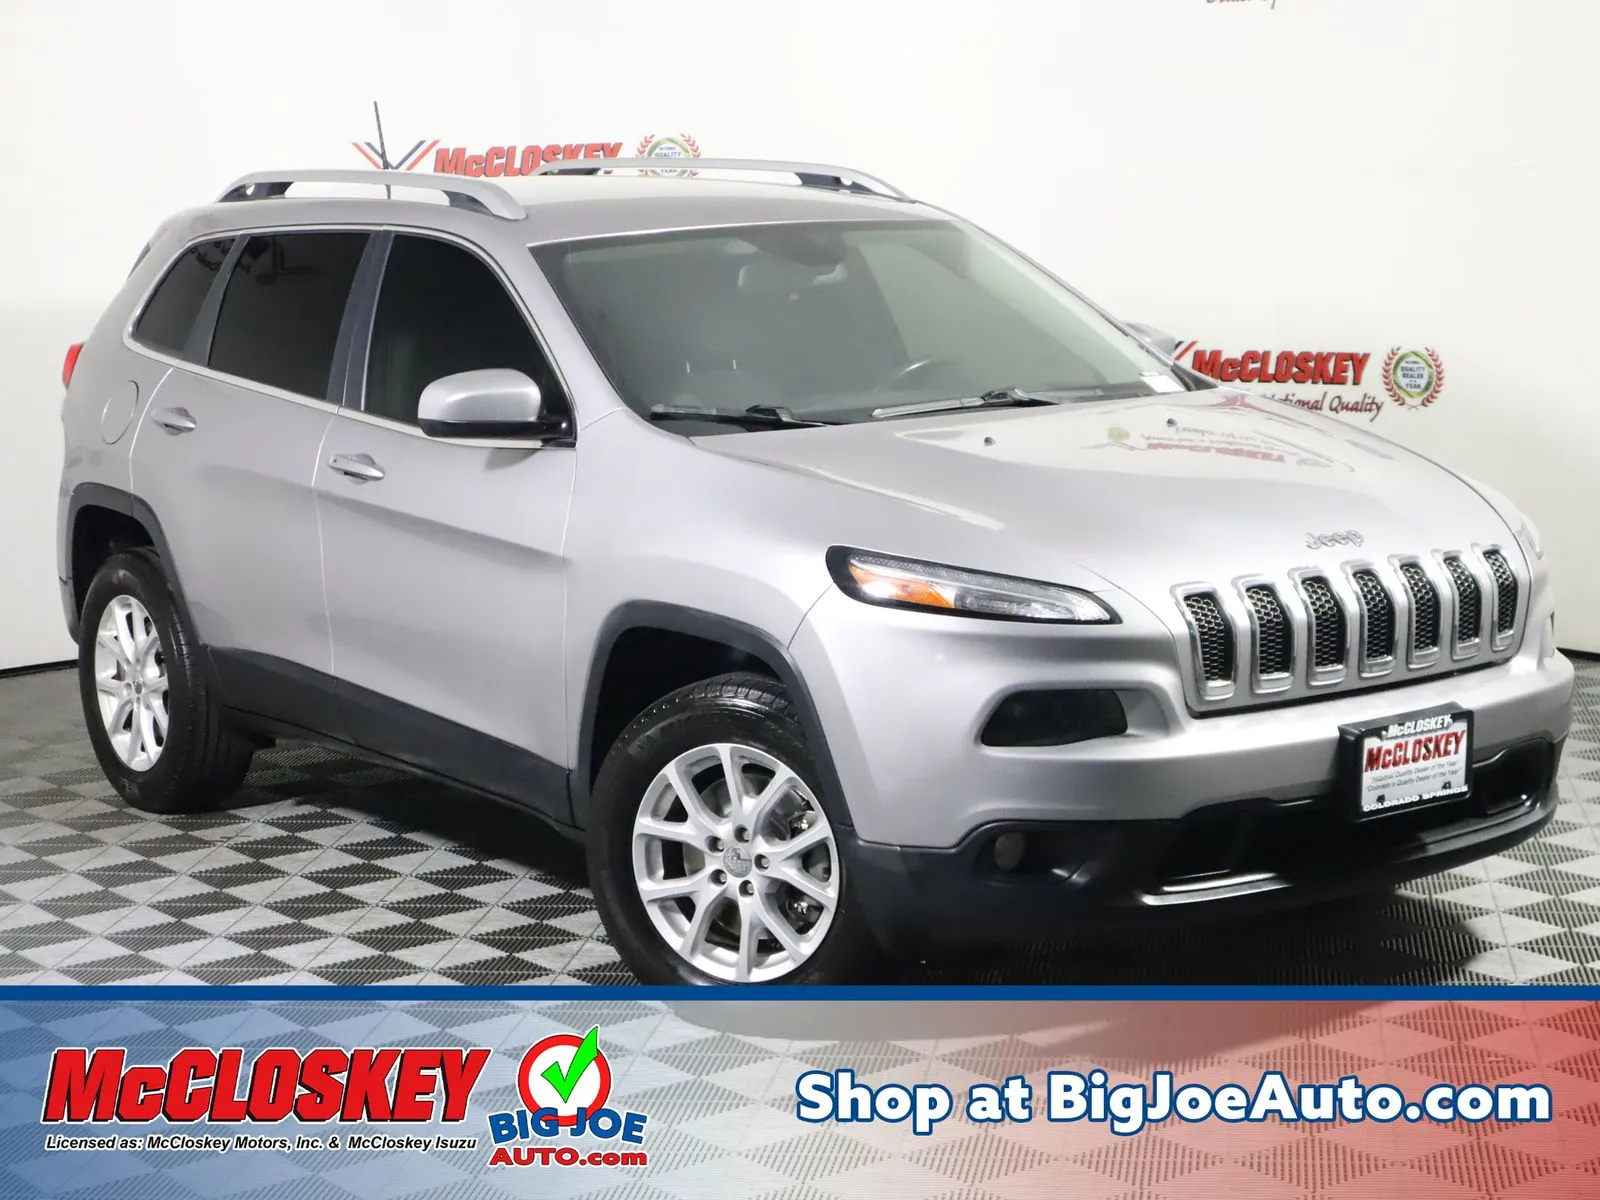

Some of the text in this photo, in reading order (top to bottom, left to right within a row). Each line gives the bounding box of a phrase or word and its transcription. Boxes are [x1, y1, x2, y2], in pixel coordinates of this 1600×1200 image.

[1192, 350, 1371, 385] McCLOSKEY
[1328, 392, 1384, 422] Quality
[1304, 530, 1364, 550] Jeep
[1386, 714, 1453, 738] McCLOSKEY
[1364, 730, 1466, 772] McCLOSKEY
[1363, 784, 1468, 812] COLORADO SPRINGS
